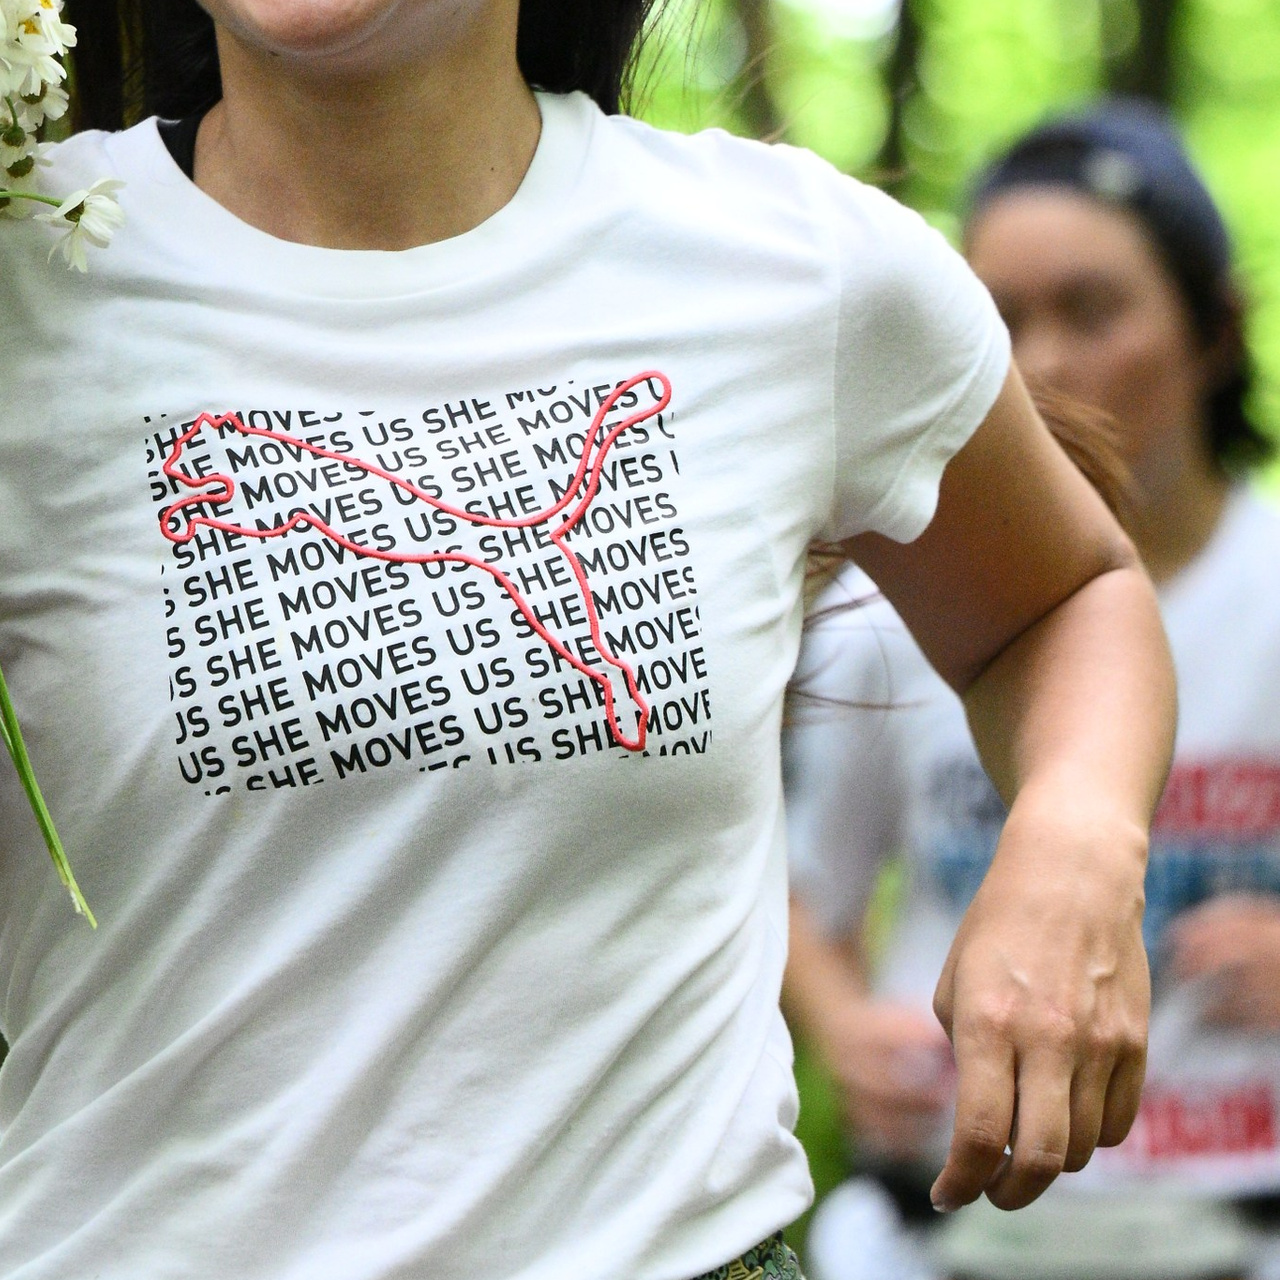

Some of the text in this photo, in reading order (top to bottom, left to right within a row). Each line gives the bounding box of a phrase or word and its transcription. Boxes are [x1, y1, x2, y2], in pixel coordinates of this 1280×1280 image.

[157, 486, 233, 534] SHE
[240, 458, 368, 510] MOVES
[376, 447, 427, 473] US
[436, 424, 511, 459] SHE
[517, 380, 639, 436] MOVES
[172, 523, 246, 569] SHE
[255, 489, 383, 543] MOVES
[389, 475, 443, 506] US
[451, 450, 527, 493] SHE
[532, 420, 650, 469] MOVES
[225, 431, 353, 473] MOVES
[362, 418, 414, 447] US
[422, 398, 497, 434] SHE
[183, 559, 258, 607] SHE
[267, 524, 396, 581] MOVES
[404, 508, 457, 543] US
[465, 485, 542, 528] SHE
[548, 454, 663, 504] MOVES
[194, 598, 270, 647] SHE
[278, 561, 410, 621] MOVES
[420, 545, 471, 579] US
[478, 519, 555, 563] SHE
[562, 493, 678, 542] MOVES
[206, 638, 282, 687] SHE
[290, 599, 422, 661] MOVES
[432, 581, 485, 617] US
[494, 555, 572, 600] SHE
[574, 528, 690, 579] MOVES
[218, 677, 295, 727] SHE
[302, 636, 436, 701] MOVES
[446, 618, 500, 656] US
[510, 593, 587, 639] SHE
[591, 566, 697, 620] MOVES
[178, 605, 702, 784] US SHE MOVES US SHE MOVE
[329, 715, 465, 779] MOVES
[473, 697, 529, 735] US
[538, 673, 616, 719] SHE
[552, 716, 622, 759] SHE
